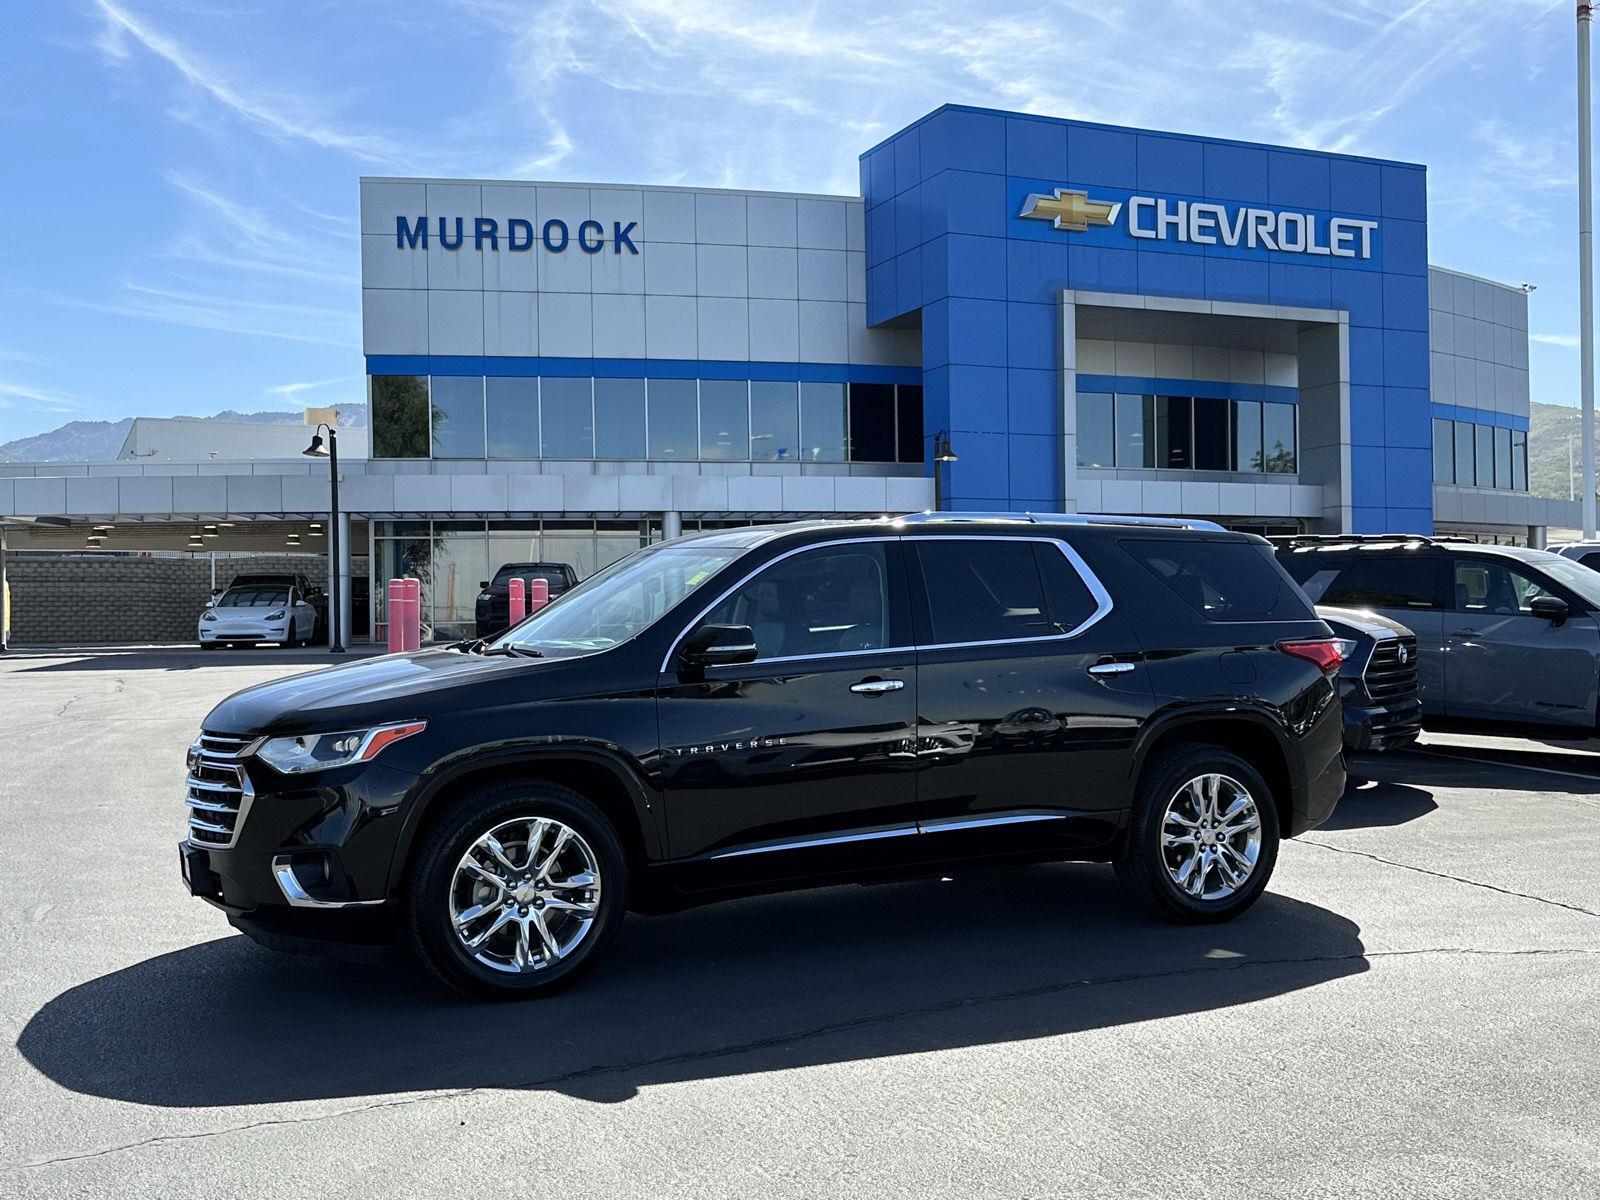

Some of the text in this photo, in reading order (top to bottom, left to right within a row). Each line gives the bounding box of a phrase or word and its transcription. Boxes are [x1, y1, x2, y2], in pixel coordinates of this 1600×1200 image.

[396, 215, 640, 255] MURDOCK
[1128, 195, 1378, 259] CHEVROLET
[675, 737, 787, 756] TRAVERSE
